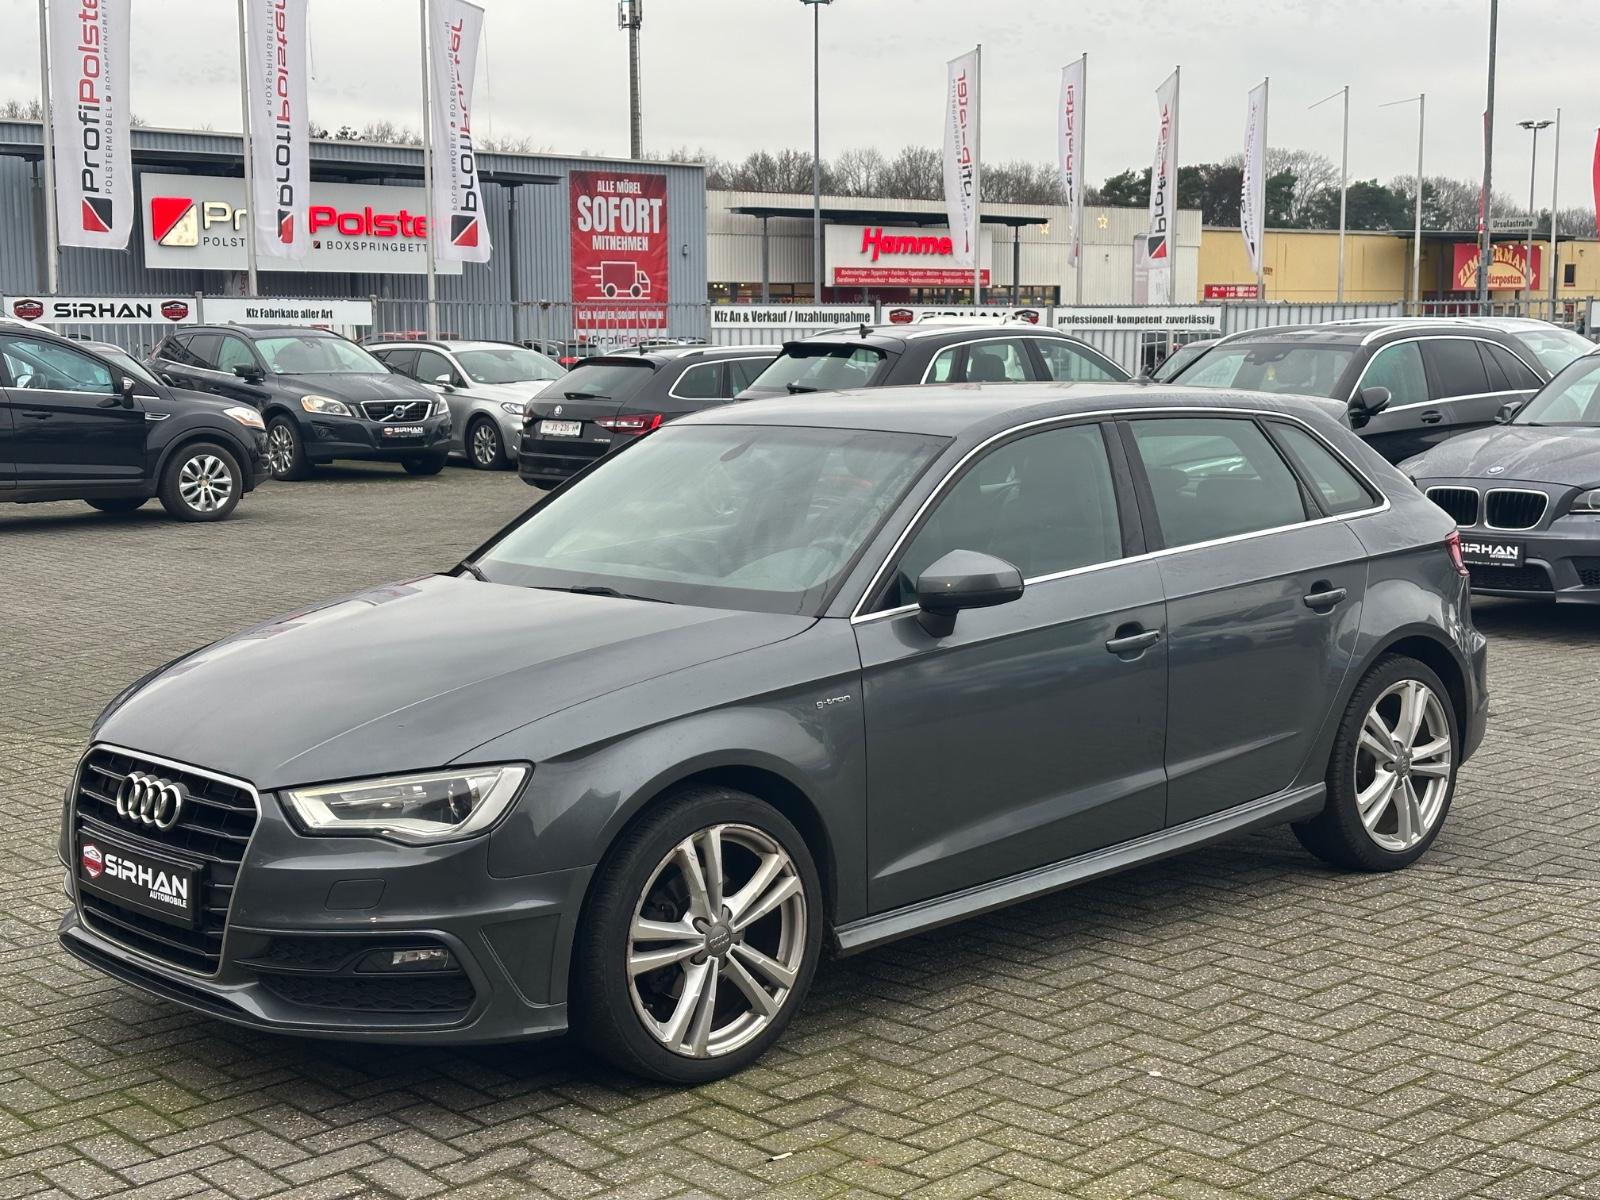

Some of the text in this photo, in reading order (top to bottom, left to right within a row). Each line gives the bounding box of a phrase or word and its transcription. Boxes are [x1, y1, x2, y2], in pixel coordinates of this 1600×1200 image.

[105, 106, 113, 194] POLSTERMÖBEL
[597, 178, 642, 194] ALLE MÖBEL
[577, 195, 663, 234] SOFORT
[592, 235, 649, 251] MITNEHMEN
[860, 226, 954, 262] Hamme
[246, 308, 333, 319] Kfz Fabrikate aller Art
[714, 310, 728, 323] Kfz
[729, 310, 741, 323] An
[743, 311, 749, 323] &
[751, 310, 787, 323] Verkauf
[794, 310, 871, 324] Inzahlungnahme
[1058, 315, 1215, 325] professionell kompetent zuverlässig
[816, 694, 851, 710] g-tron
[149, 889, 188, 909] AUTOMOBILE
